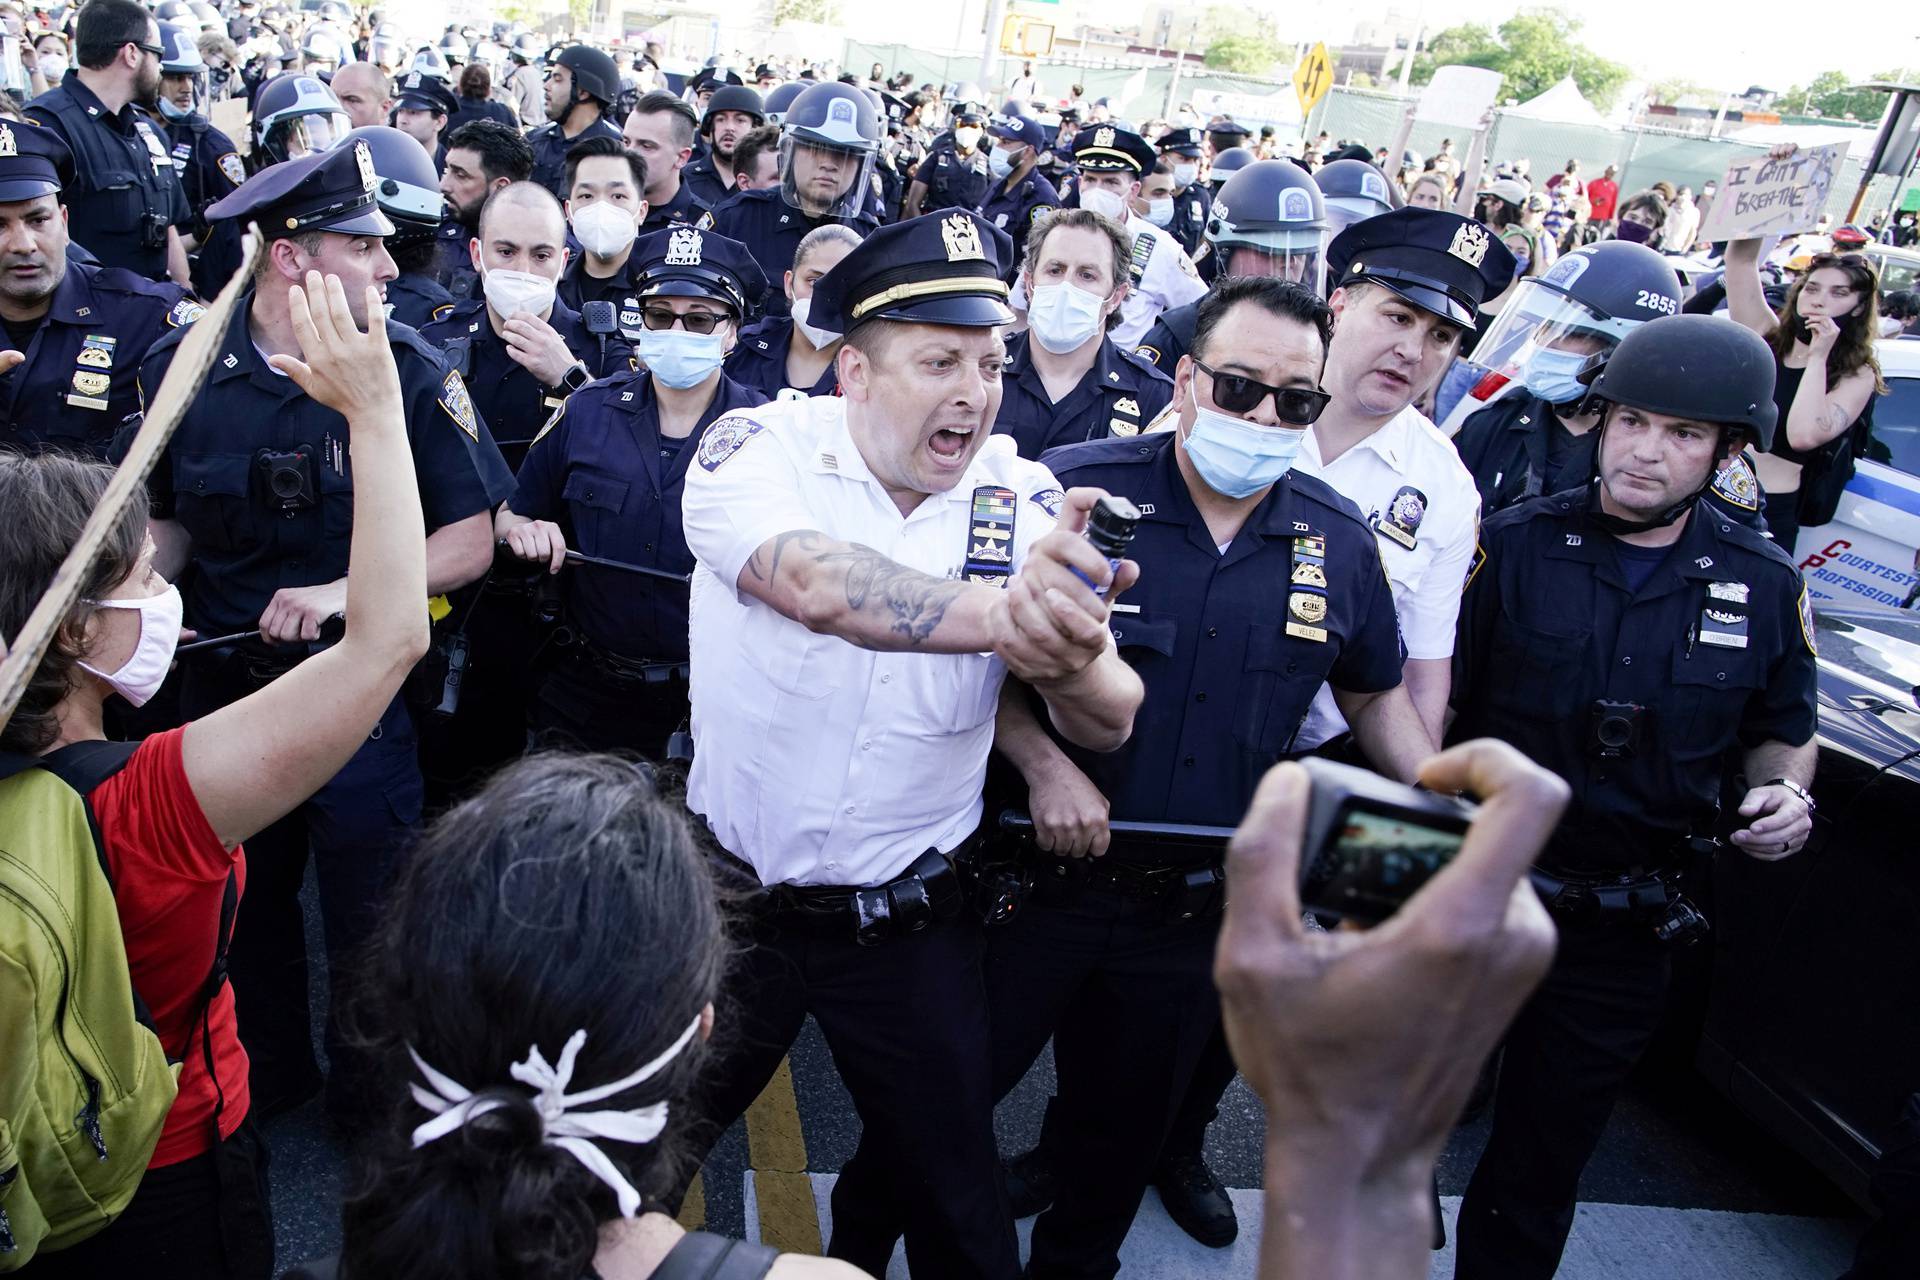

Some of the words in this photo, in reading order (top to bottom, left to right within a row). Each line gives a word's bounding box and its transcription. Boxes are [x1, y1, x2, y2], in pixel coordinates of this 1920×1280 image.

[1728, 166, 1750, 187] I
[1635, 289, 1677, 316] 2855
[1798, 554, 1904, 609] PROFESSION
[1821, 540, 1919, 587] COURTESY
